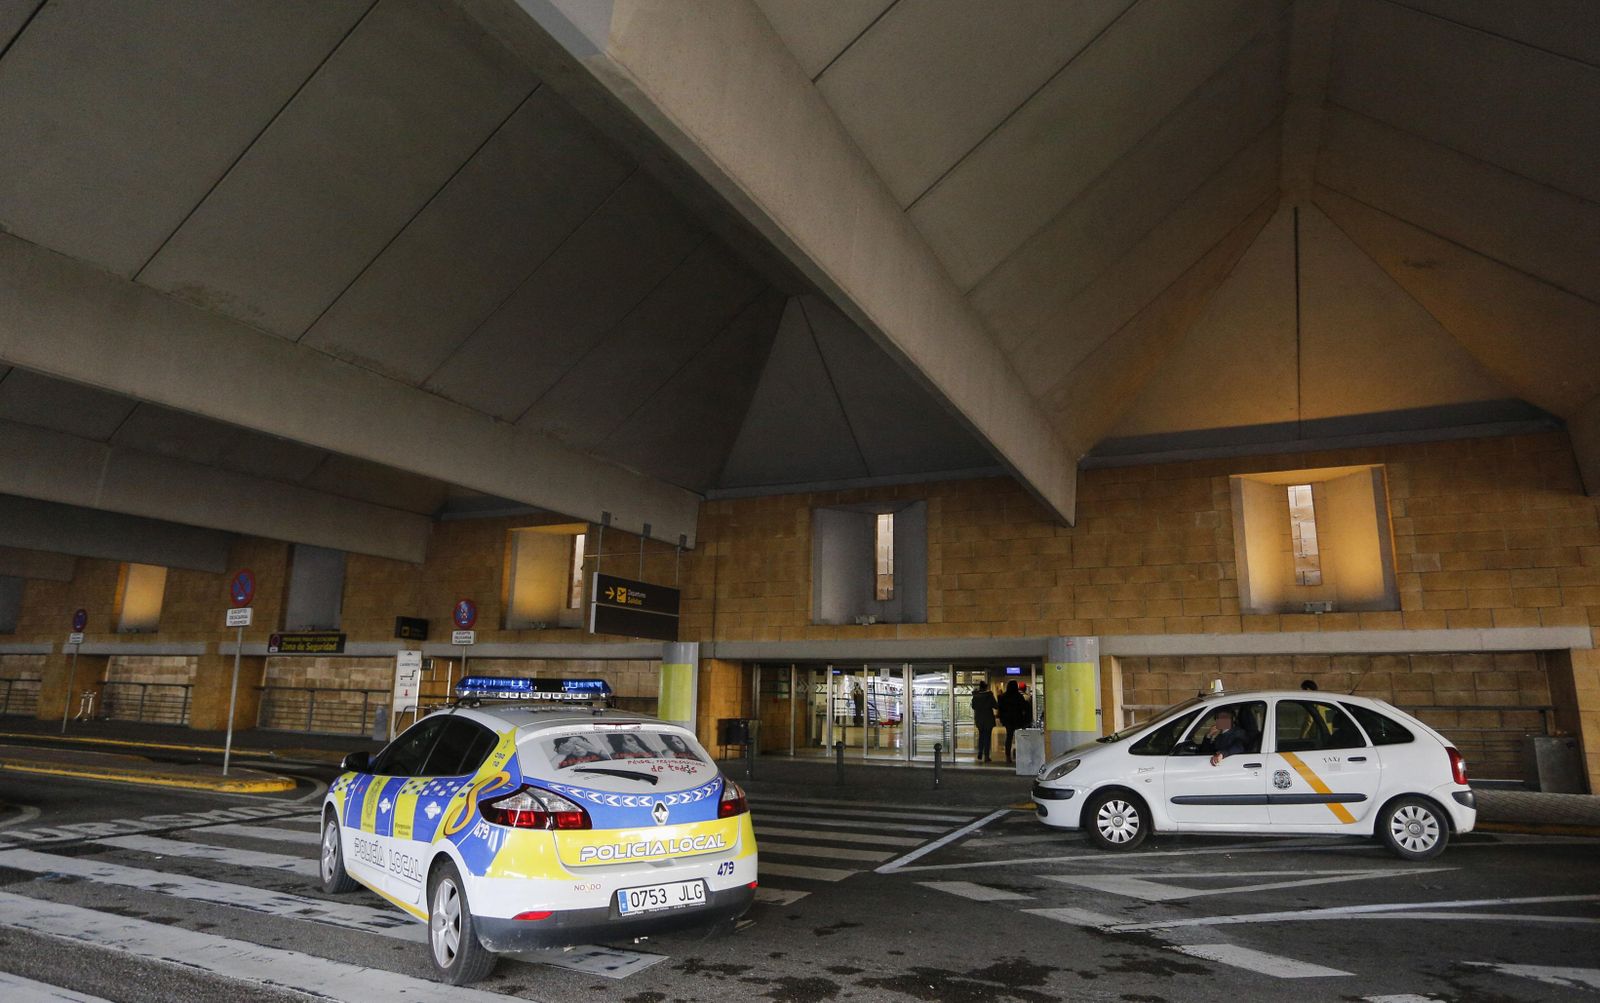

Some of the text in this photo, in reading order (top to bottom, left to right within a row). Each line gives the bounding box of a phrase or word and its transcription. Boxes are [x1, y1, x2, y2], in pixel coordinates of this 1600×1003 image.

[297, 641, 305, 651] de
[306, 642, 336, 652] Seguridad
[474, 823, 489, 839] 479
[668, 833, 726, 855] LOCAL
[388, 848, 423, 883] LOCAL
[717, 861, 735, 876] 479
[630, 887, 668, 909] 0753
[678, 883, 703, 902] JLG
